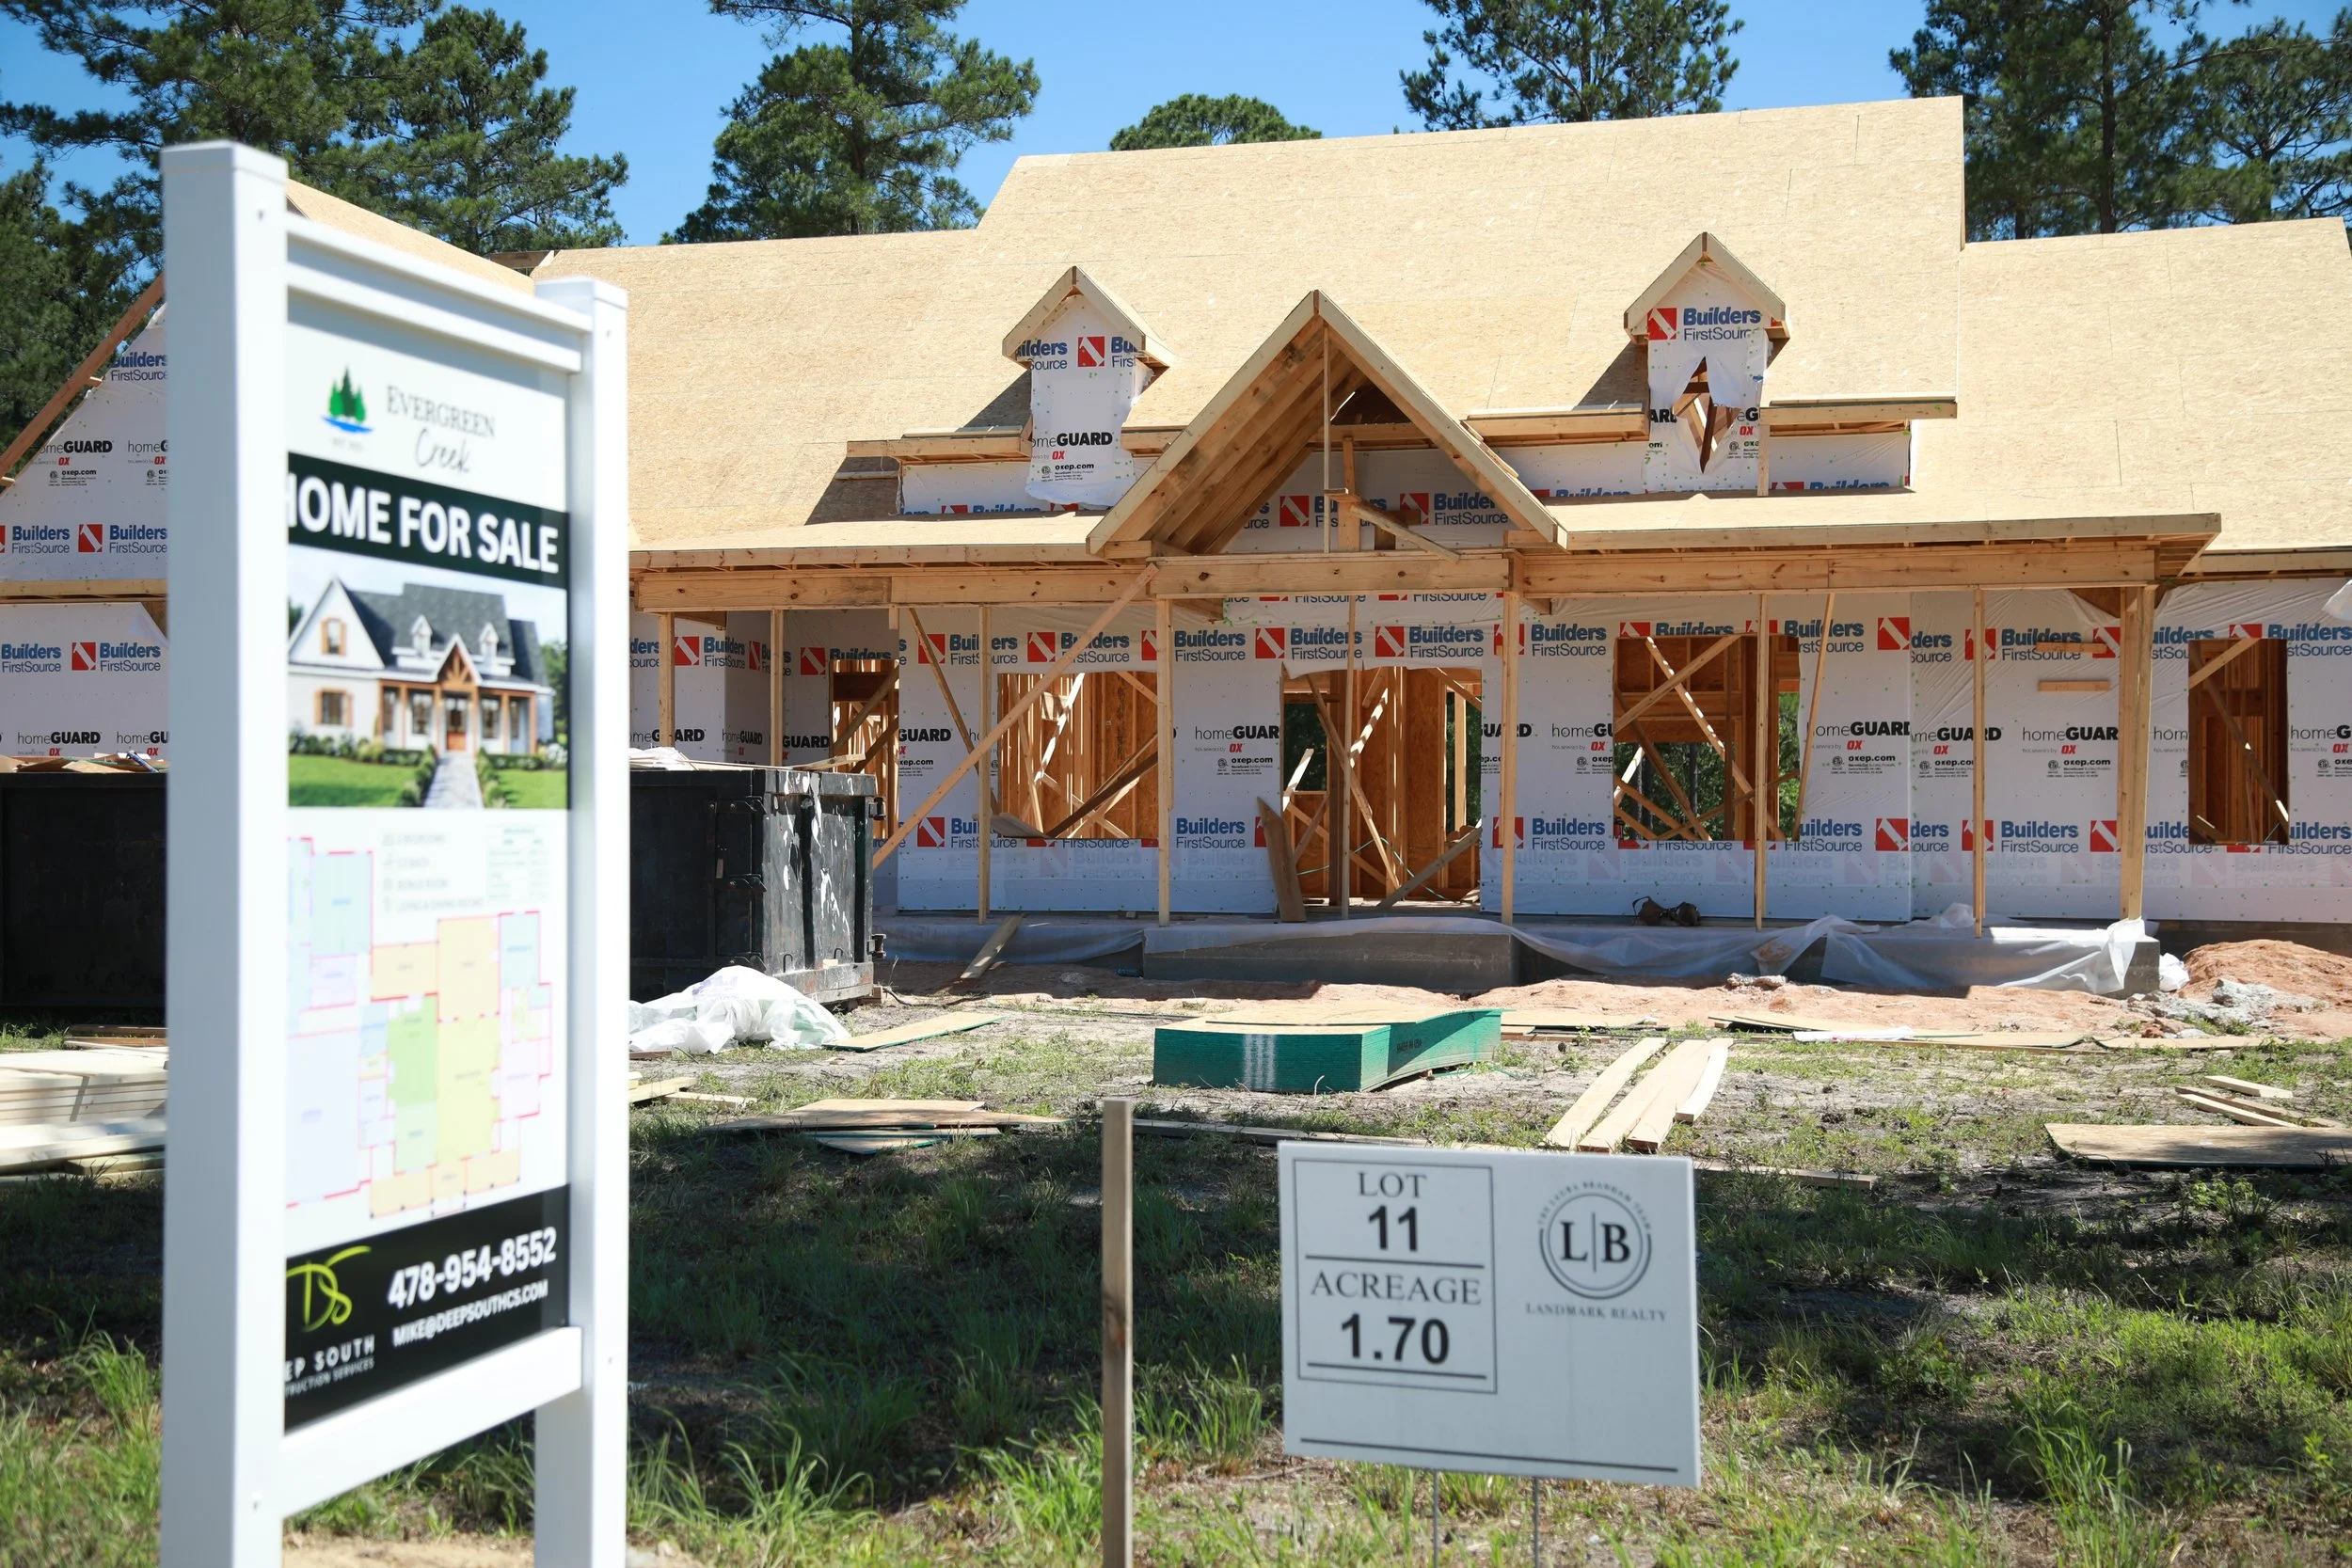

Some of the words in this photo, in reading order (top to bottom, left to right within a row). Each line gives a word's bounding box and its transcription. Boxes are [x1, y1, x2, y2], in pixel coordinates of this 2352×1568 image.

[1683, 307, 1761, 325] Builders
[111, 370, 167, 382] FirstSource
[386, 385, 496, 437] EVERGREEN
[1739, 425, 1755, 436] OX
[415, 426, 470, 473] Creek
[1052, 451, 1065, 460] OX
[58, 457, 70, 466] OX
[154, 456, 166, 465] OX
[1055, 463, 1094, 471] oxep.com
[61, 469, 97, 478] oxep.com
[1434, 512, 1508, 525] FirstSource
[12, 525, 71, 540] Builders
[109, 524, 167, 540] Builders
[400, 495, 471, 559] FOR
[477, 512, 560, 575] SALE
[11, 543, 71, 555] FirstSource
[109, 542, 167, 554] FirstSource
[1175, 629, 1246, 648] Builders
[1408, 626, 1485, 644] Builders
[1532, 623, 1607, 641] Builders
[2001, 628, 2082, 646] Builders
[2267, 624, 2352, 641] Builders
[704, 636, 745, 657] Builders
[949, 633, 1018, 651] Builers
[1, 643, 62, 658] Builders
[100, 642, 161, 657] Builders
[1175, 649, 1246, 662] FirstSource
[1409, 644, 1485, 658] FirstSource
[1532, 643, 1607, 657] FirstSource
[100, 659, 161, 672] FirstSource
[705, 657, 746, 670] FirstSource
[950, 652, 1018, 665] FirstSurce
[2, 661, 62, 673] FirstSource
[17, 731, 102, 745] homeGUARD
[723, 728, 763, 744] homeGUARD
[49, 748, 61, 756] OX
[147, 747, 159, 756] OX
[1229, 743, 1243, 752] OX
[1590, 741, 1606, 752] OX
[1846, 740, 1863, 751] OX
[1933, 745, 1949, 754] OX
[2060, 744, 2076, 754] OX
[2332, 743, 2348, 753] OX
[1231, 756, 1274, 765] oxep.com
[1848, 754, 1896, 763] oxep.com
[2063, 758, 2111, 768] oxep.com
[1176, 817, 1246, 834] Builders
[1532, 817, 1606, 836] Builders
[2001, 821, 2079, 838] Builders
[1176, 836, 1246, 849] FirstSource
[1532, 837, 1606, 851] FirstSource
[2001, 840, 2079, 853] FirstSource
[1358, 1172, 1427, 1198] LOT
[1368, 1205, 1419, 1252] 11
[387, 1227, 557, 1310] 478-954-8552
[1311, 1270, 1483, 1306] ACREAGE
[392, 1279, 548, 1347] MIKE@DEEPSOUTHCS.COM
[1526, 1303, 1606, 1319] LANDMARK
[1611, 1307, 1667, 1322] REALTY
[1341, 1313, 1451, 1365] 1.70
[314, 1334, 374, 1372] SOUTH
